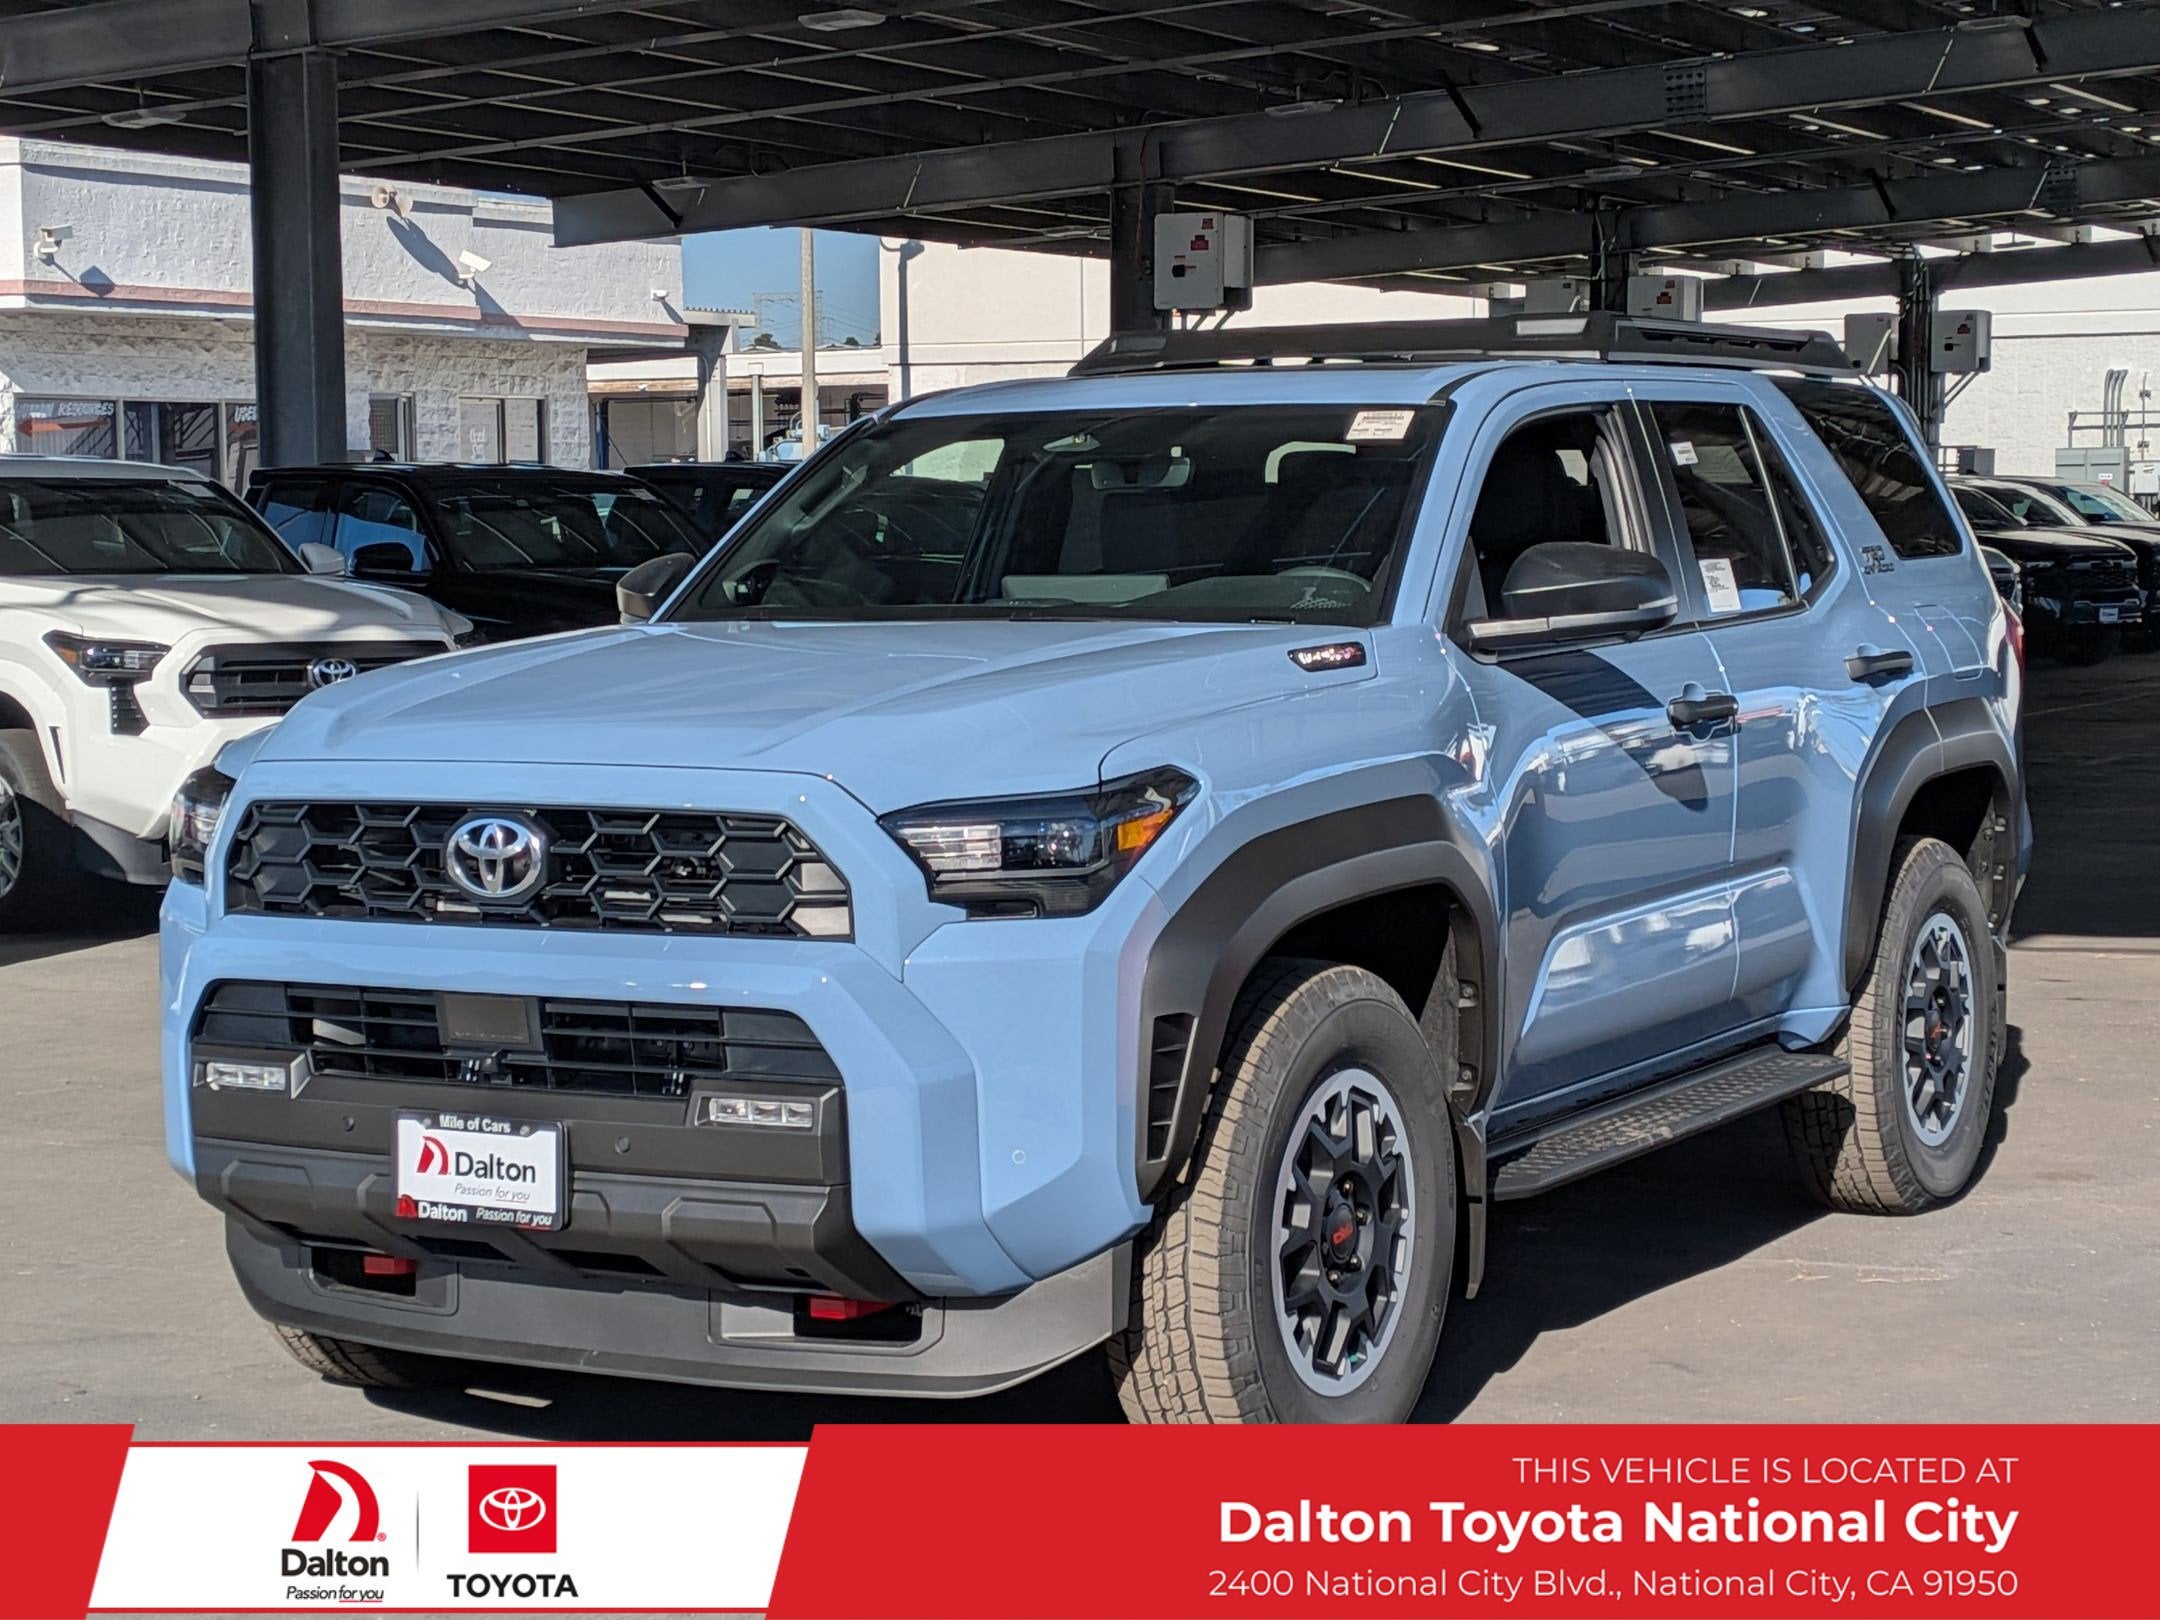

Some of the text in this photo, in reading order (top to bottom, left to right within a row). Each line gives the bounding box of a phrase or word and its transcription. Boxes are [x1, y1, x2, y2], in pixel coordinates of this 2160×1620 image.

[439, 1114, 511, 1134] Mile of Cars
[455, 1151, 536, 1184] Dalton
[454, 1183, 531, 1202] Passion for you
[418, 1201, 468, 1222] Dalton
[475, 1207, 552, 1227] Passion for you
